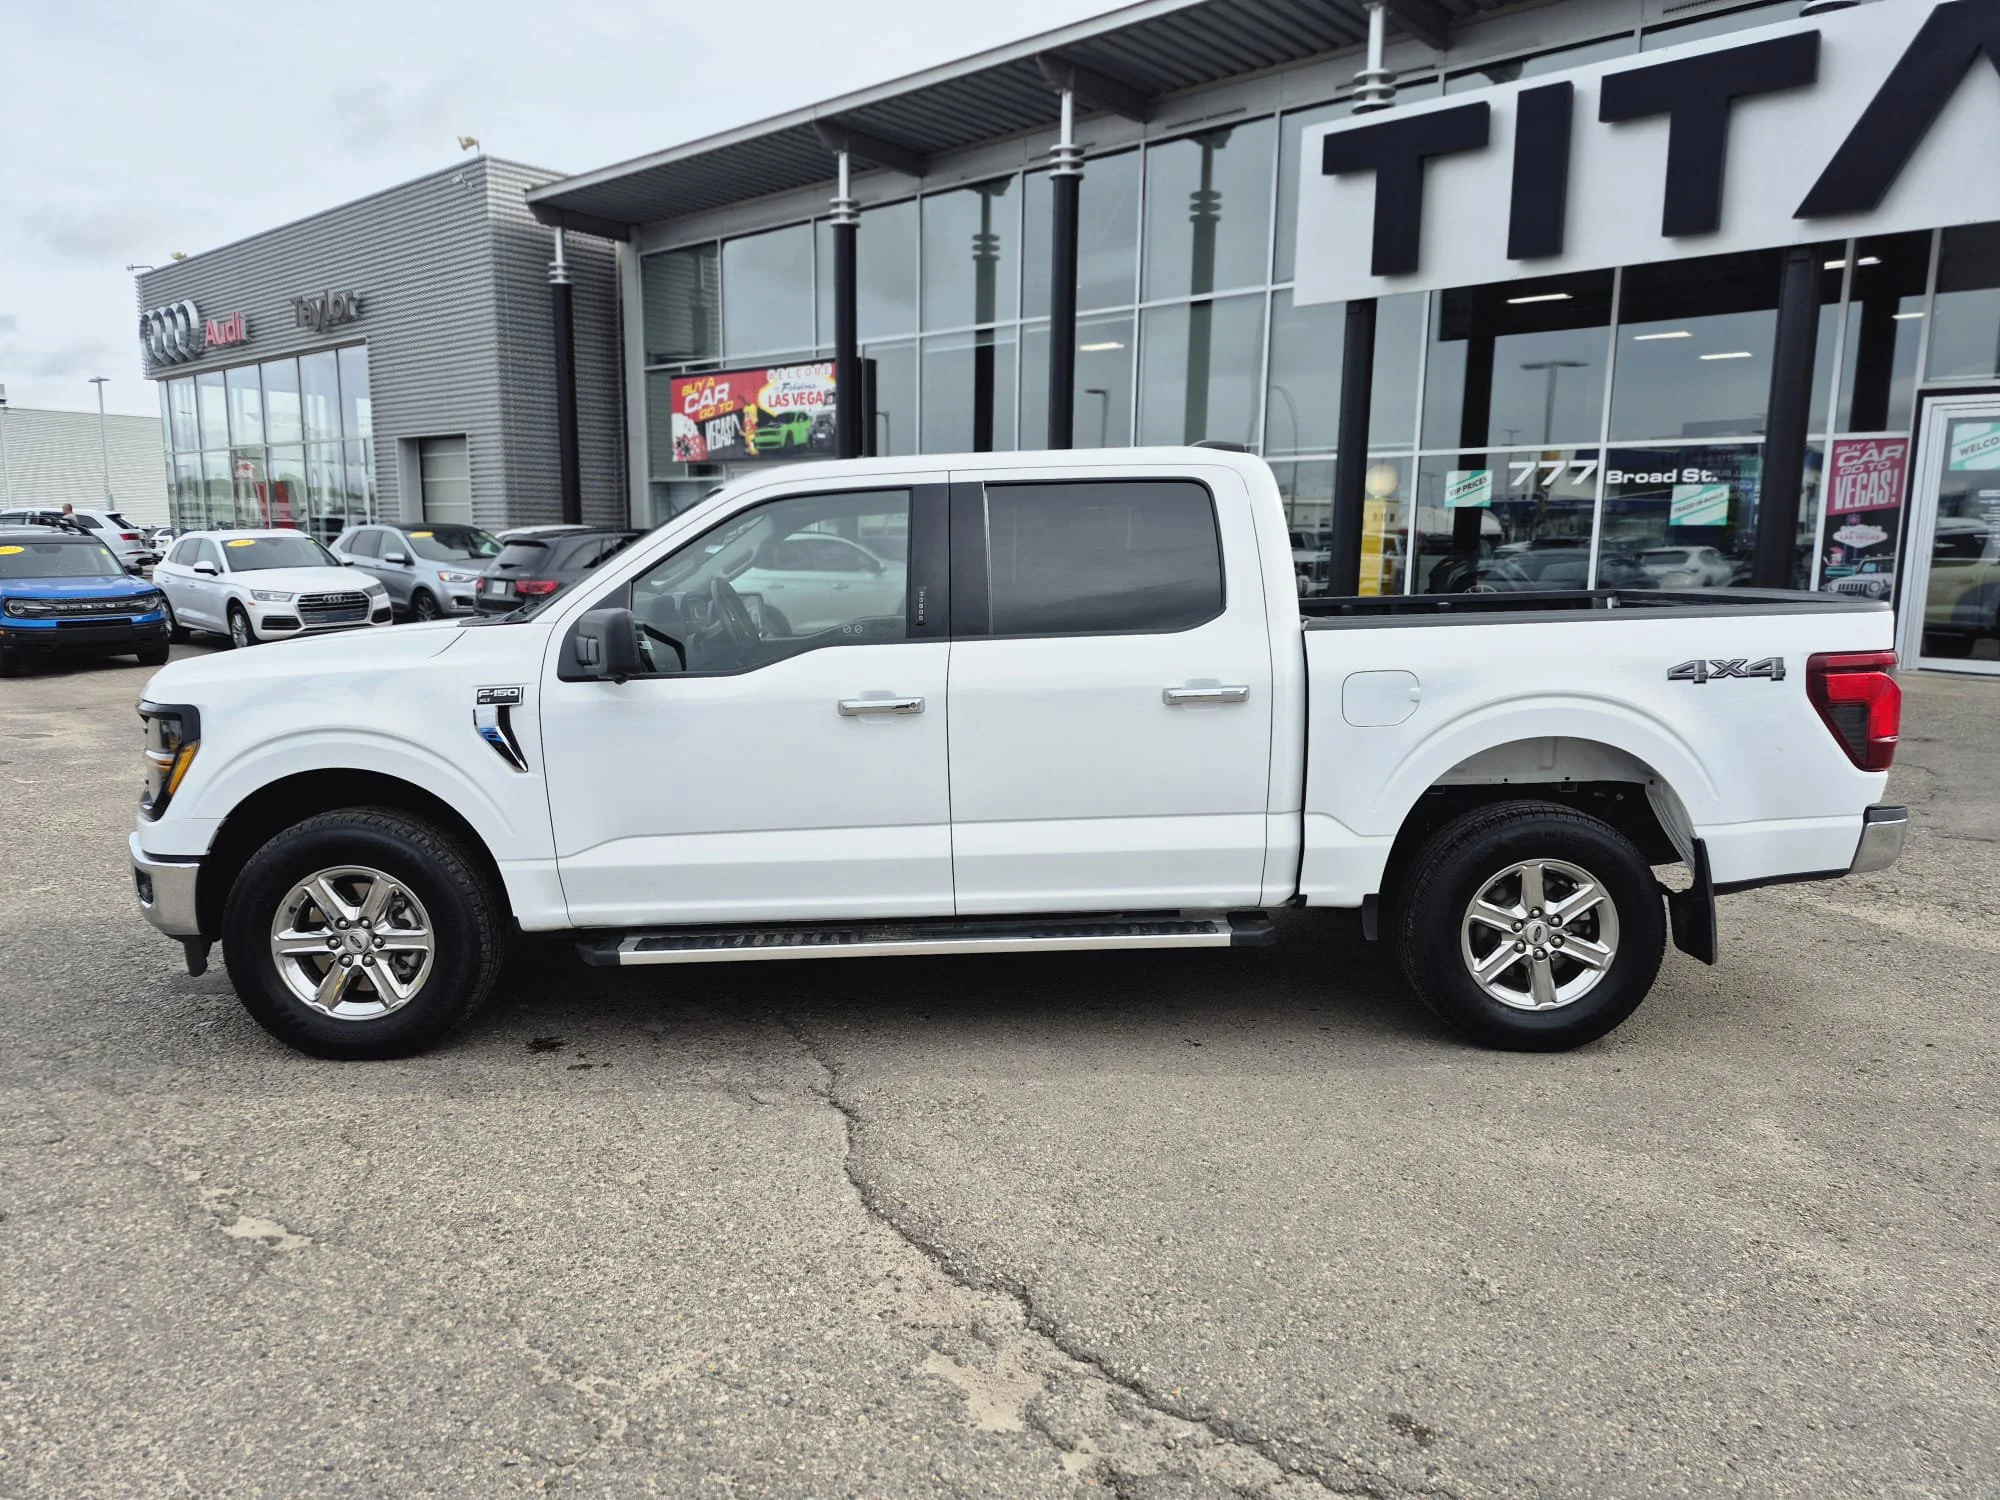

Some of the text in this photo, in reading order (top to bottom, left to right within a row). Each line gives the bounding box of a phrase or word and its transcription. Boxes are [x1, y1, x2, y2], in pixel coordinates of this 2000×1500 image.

[291, 289, 358, 332] Taylor
[205, 311, 247, 347] Audi
[768, 364, 832, 380] WELCOME
[682, 376, 715, 397] BUY A
[685, 382, 730, 414] CAR
[768, 391, 826, 408] LAS VEGA
[699, 400, 735, 420] GO TO
[705, 414, 736, 452] VEGAS!
[1836, 441, 1877, 454] BUY A
[1837, 445, 1904, 467] CAR
[1508, 460, 1598, 486] 777
[1605, 469, 1677, 484] Broad
[1682, 468, 1718, 482] St.
[1839, 461, 1891, 476] GO TO
[1448, 476, 1488, 497] VIP PRICES
[1834, 468, 1900, 510] VEGAS!
[478, 688, 519, 698] F-150
